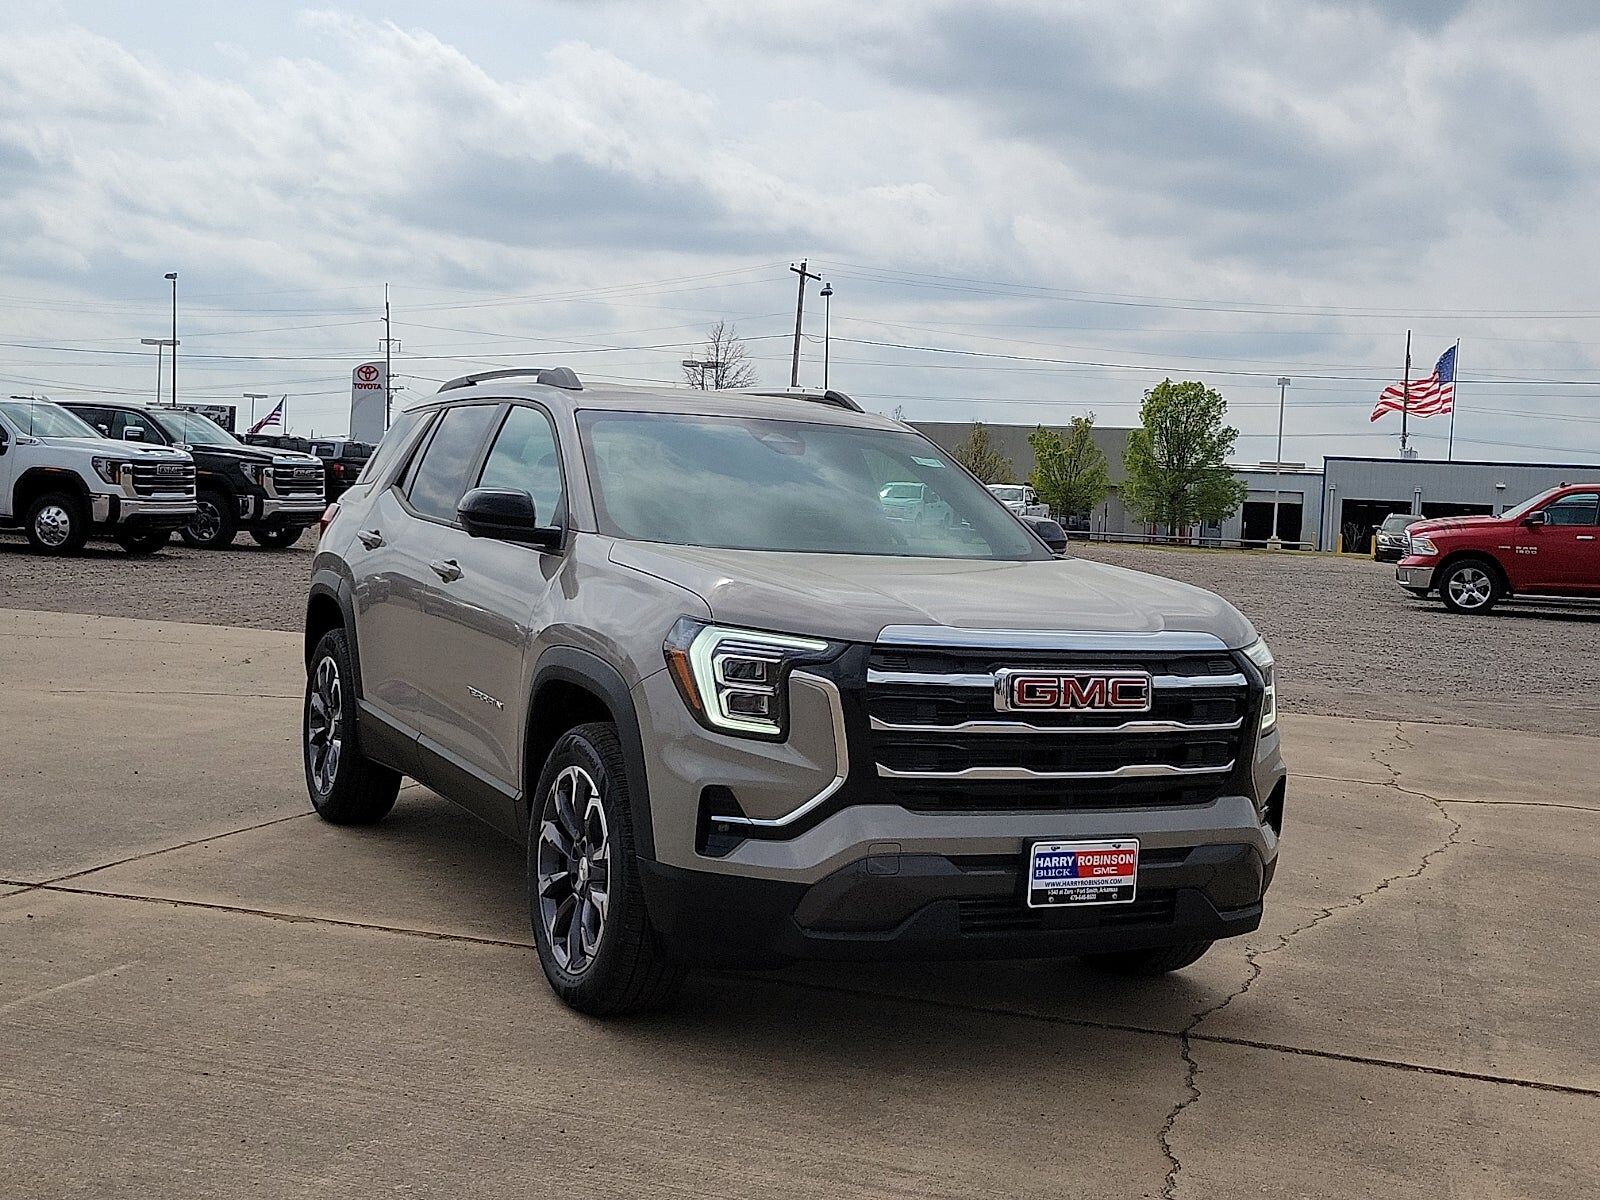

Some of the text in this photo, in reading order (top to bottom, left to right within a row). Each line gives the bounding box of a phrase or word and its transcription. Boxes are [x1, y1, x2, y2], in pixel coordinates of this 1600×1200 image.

[1014, 677, 1148, 707] GMC
[1035, 853, 1134, 868] HARRY ROBINSON
[1035, 868, 1073, 877] BUICK
[1093, 866, 1118, 875] GMC
[1045, 878, 1122, 888] WWW.HARRYROBINSON.COM
